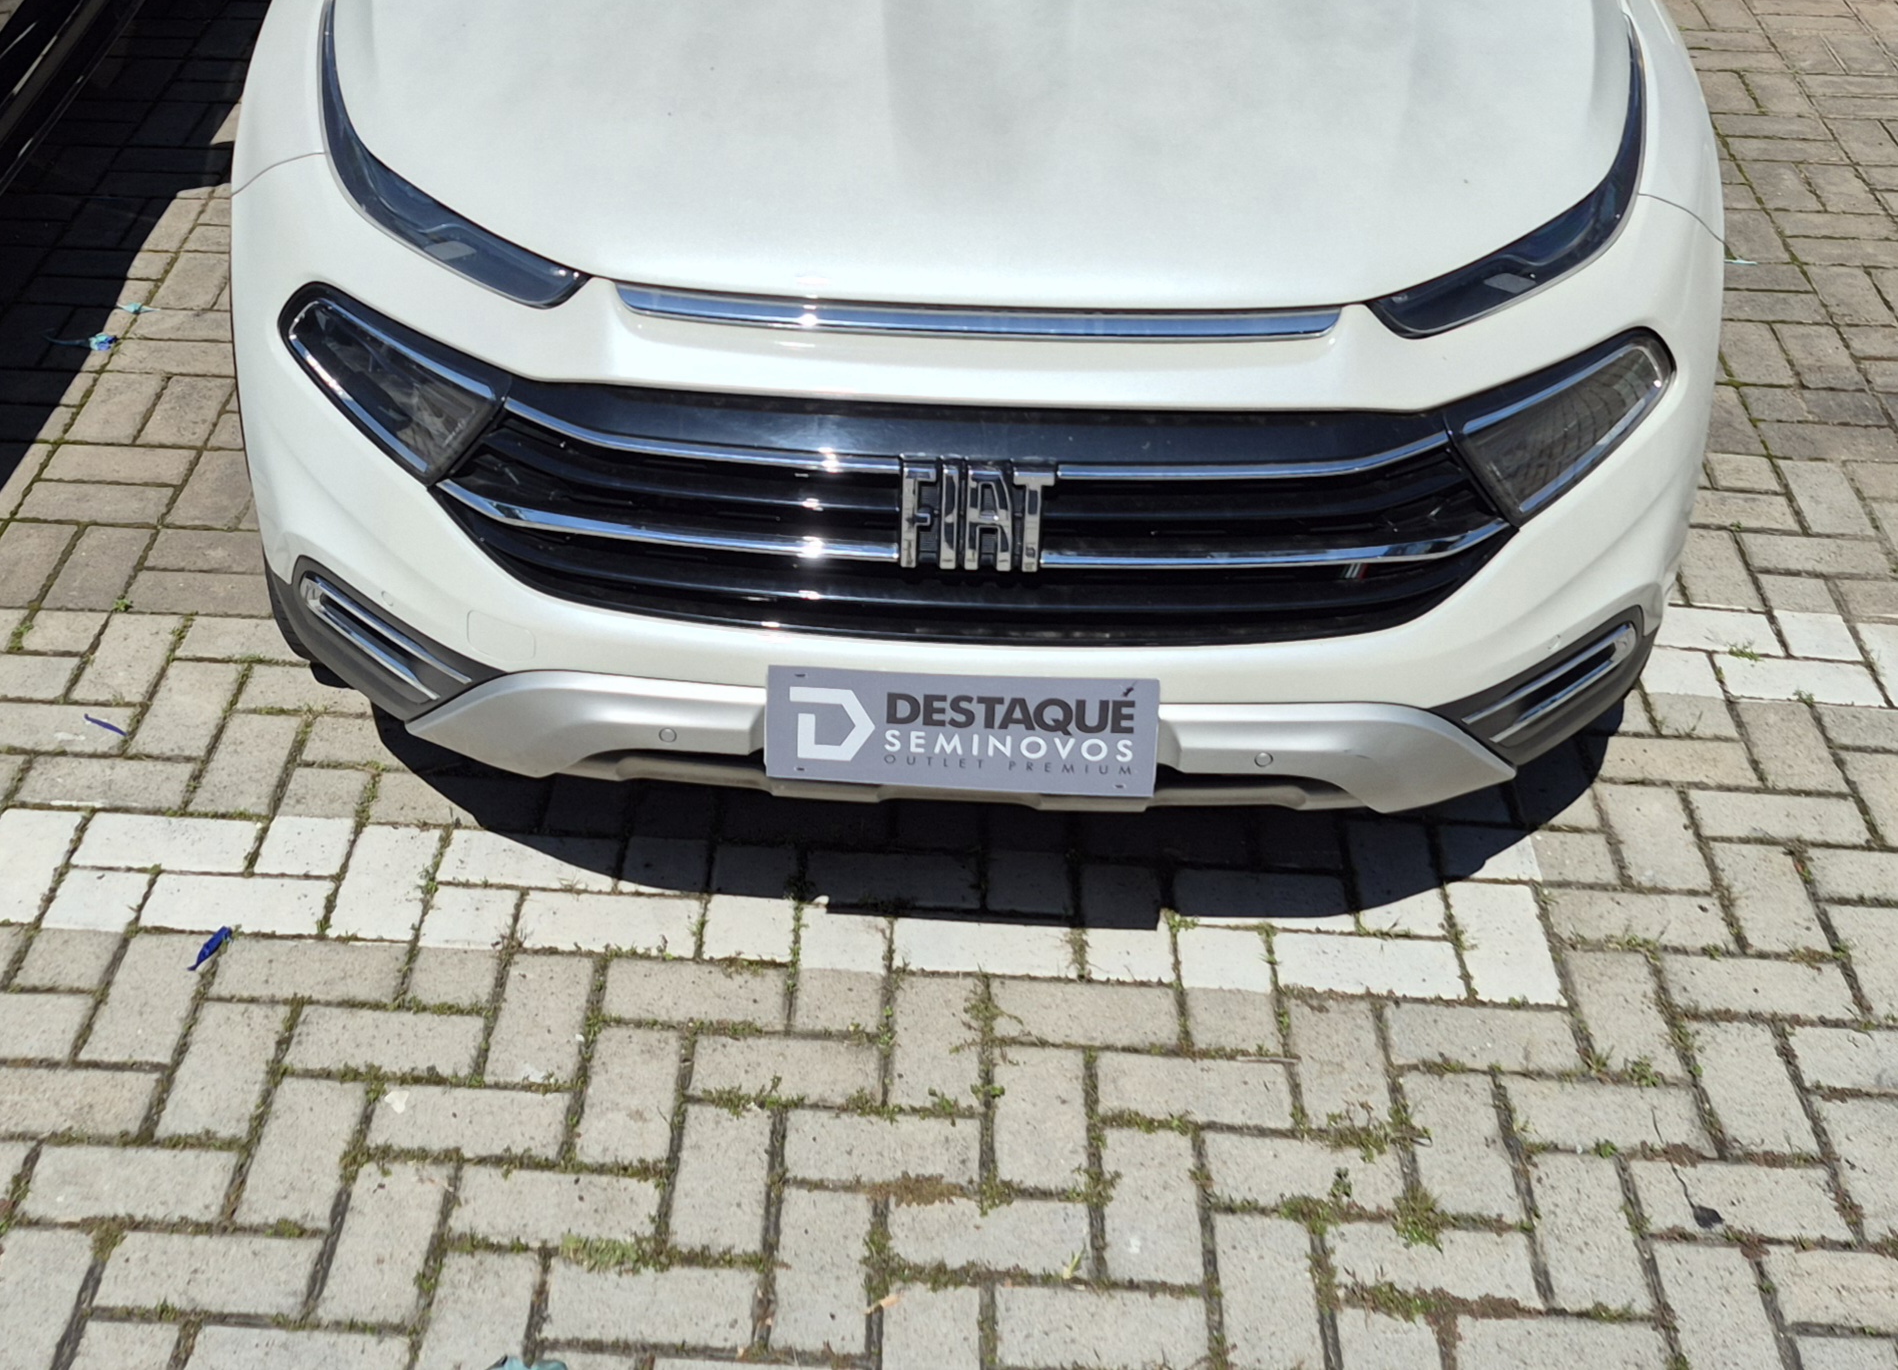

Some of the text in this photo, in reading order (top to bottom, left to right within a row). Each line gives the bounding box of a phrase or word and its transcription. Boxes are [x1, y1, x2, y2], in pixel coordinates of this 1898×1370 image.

[901, 460, 1056, 572] FIAT
[883, 729, 1133, 763] SEMINOVOS
[883, 754, 1133, 776] OUTLET PREMIUM
